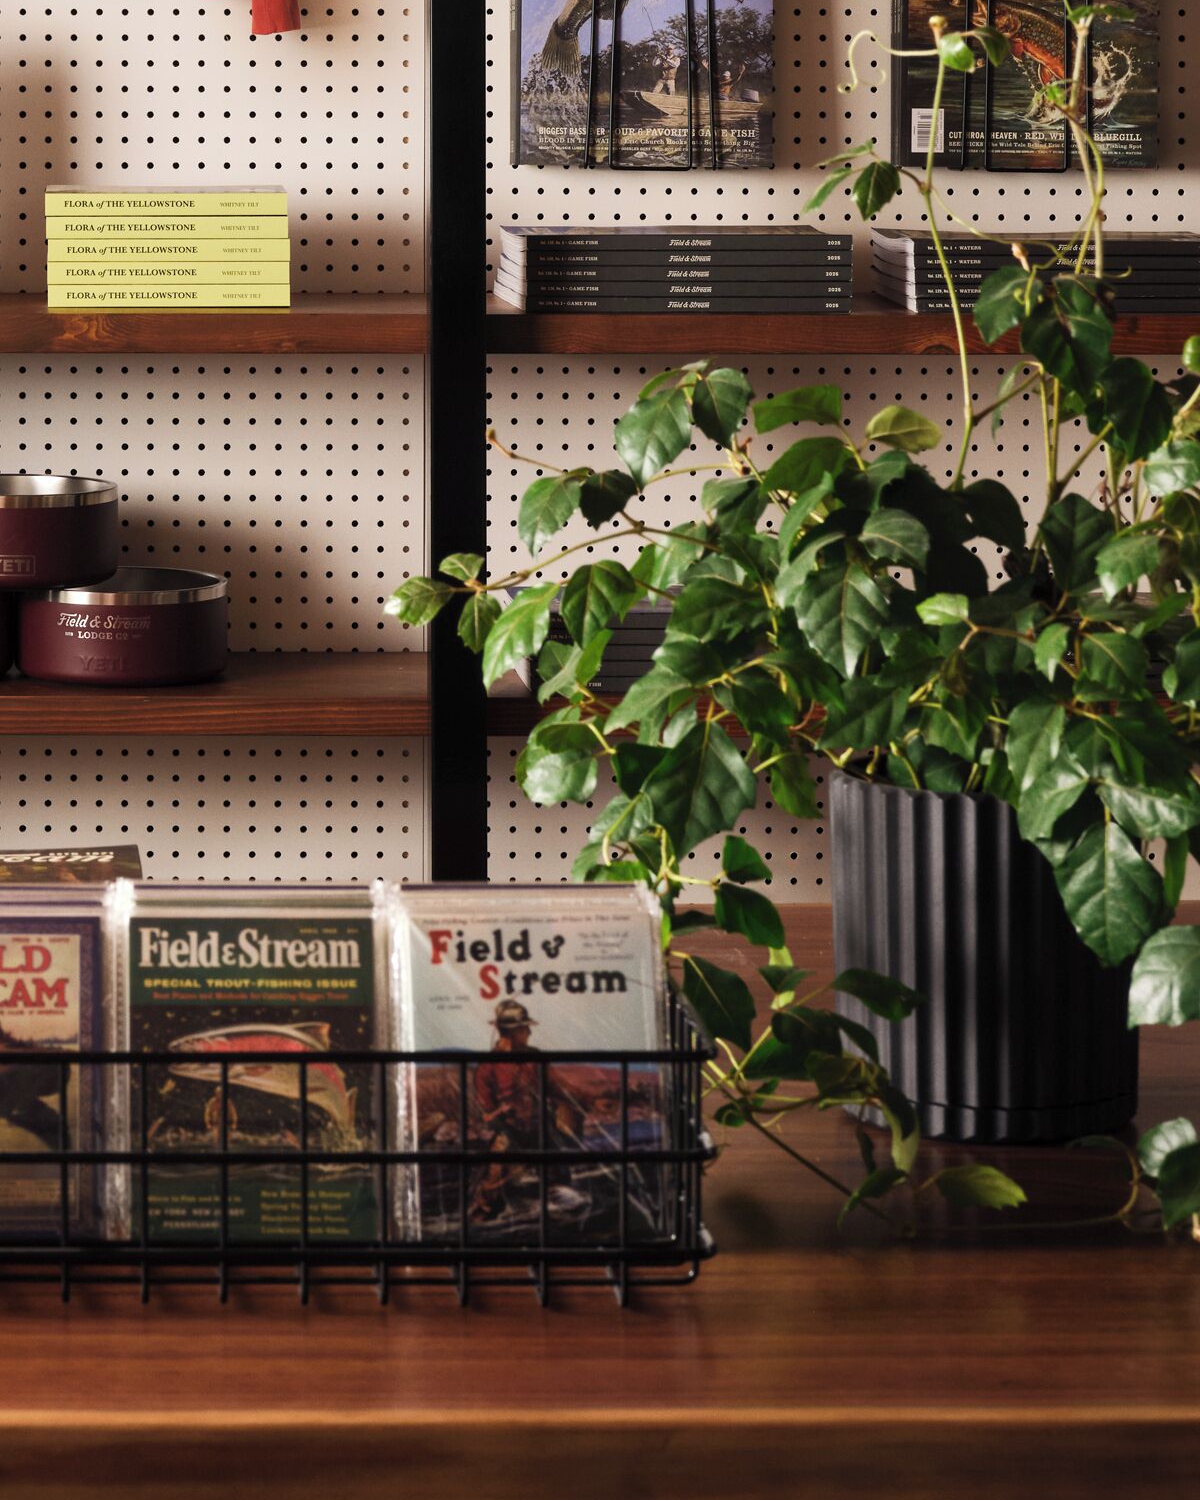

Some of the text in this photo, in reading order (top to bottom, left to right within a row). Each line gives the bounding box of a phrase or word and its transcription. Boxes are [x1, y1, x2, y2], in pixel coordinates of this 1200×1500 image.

[539, 127, 587, 135] BIGGEST BASS
[731, 129, 756, 138] FISH
[1093, 133, 1142, 141] BLUEGILL
[64, 200, 195, 209] FLORA of THE YELLOWSTONE
[65, 223, 196, 233] FLORA of THE YELLOWSTONE
[67, 246, 198, 256] FLORA of THE YELLOWSTONE
[66, 268, 197, 278] FLORA of THE YELLOWSTONE
[66, 291, 198, 301] FLORA of THE YELLOWSTONE
[57, 612, 151, 629] Field & Stream
[77, 631, 113, 640] LODGE
[428, 928, 532, 964] Field
[541, 935, 565, 959] &
[143, 979, 201, 988] SPECIAL
[316, 979, 358, 988] ISSUE
[479, 964, 627, 1000] Stream
